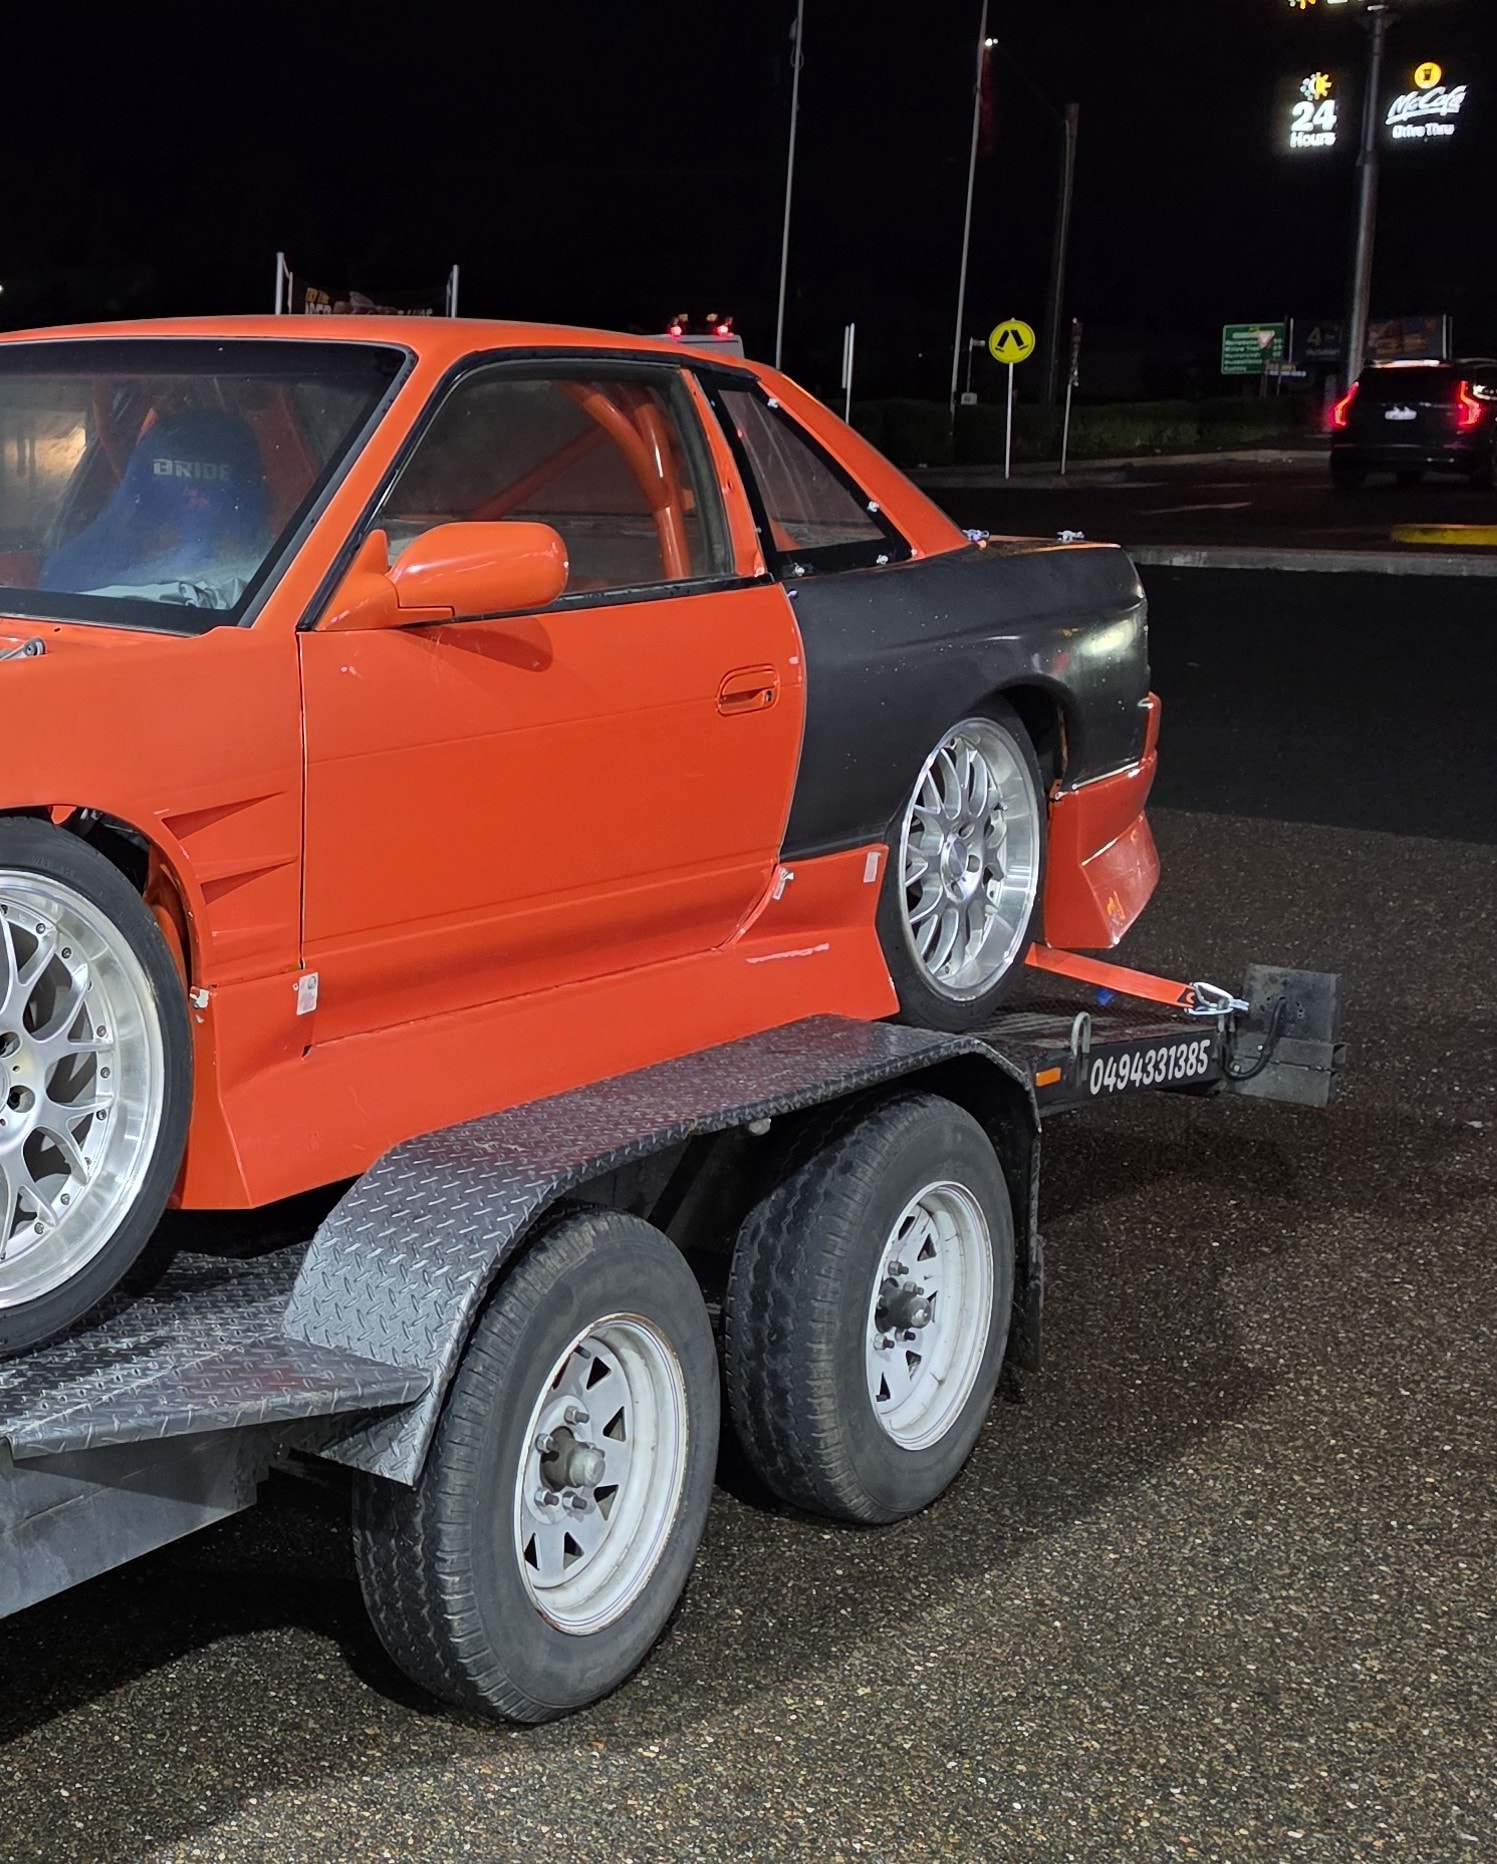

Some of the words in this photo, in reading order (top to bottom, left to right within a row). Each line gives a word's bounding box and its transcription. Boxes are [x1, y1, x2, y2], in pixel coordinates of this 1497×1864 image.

[1291, 100, 1337, 131] 24
[1290, 131, 1336, 148] Hours
[1392, 125, 1425, 138] Drive
[1425, 122, 1455, 136] Thru
[153, 458, 230, 480] BRIDE
[1089, 1039, 1211, 1096] 0494331385
